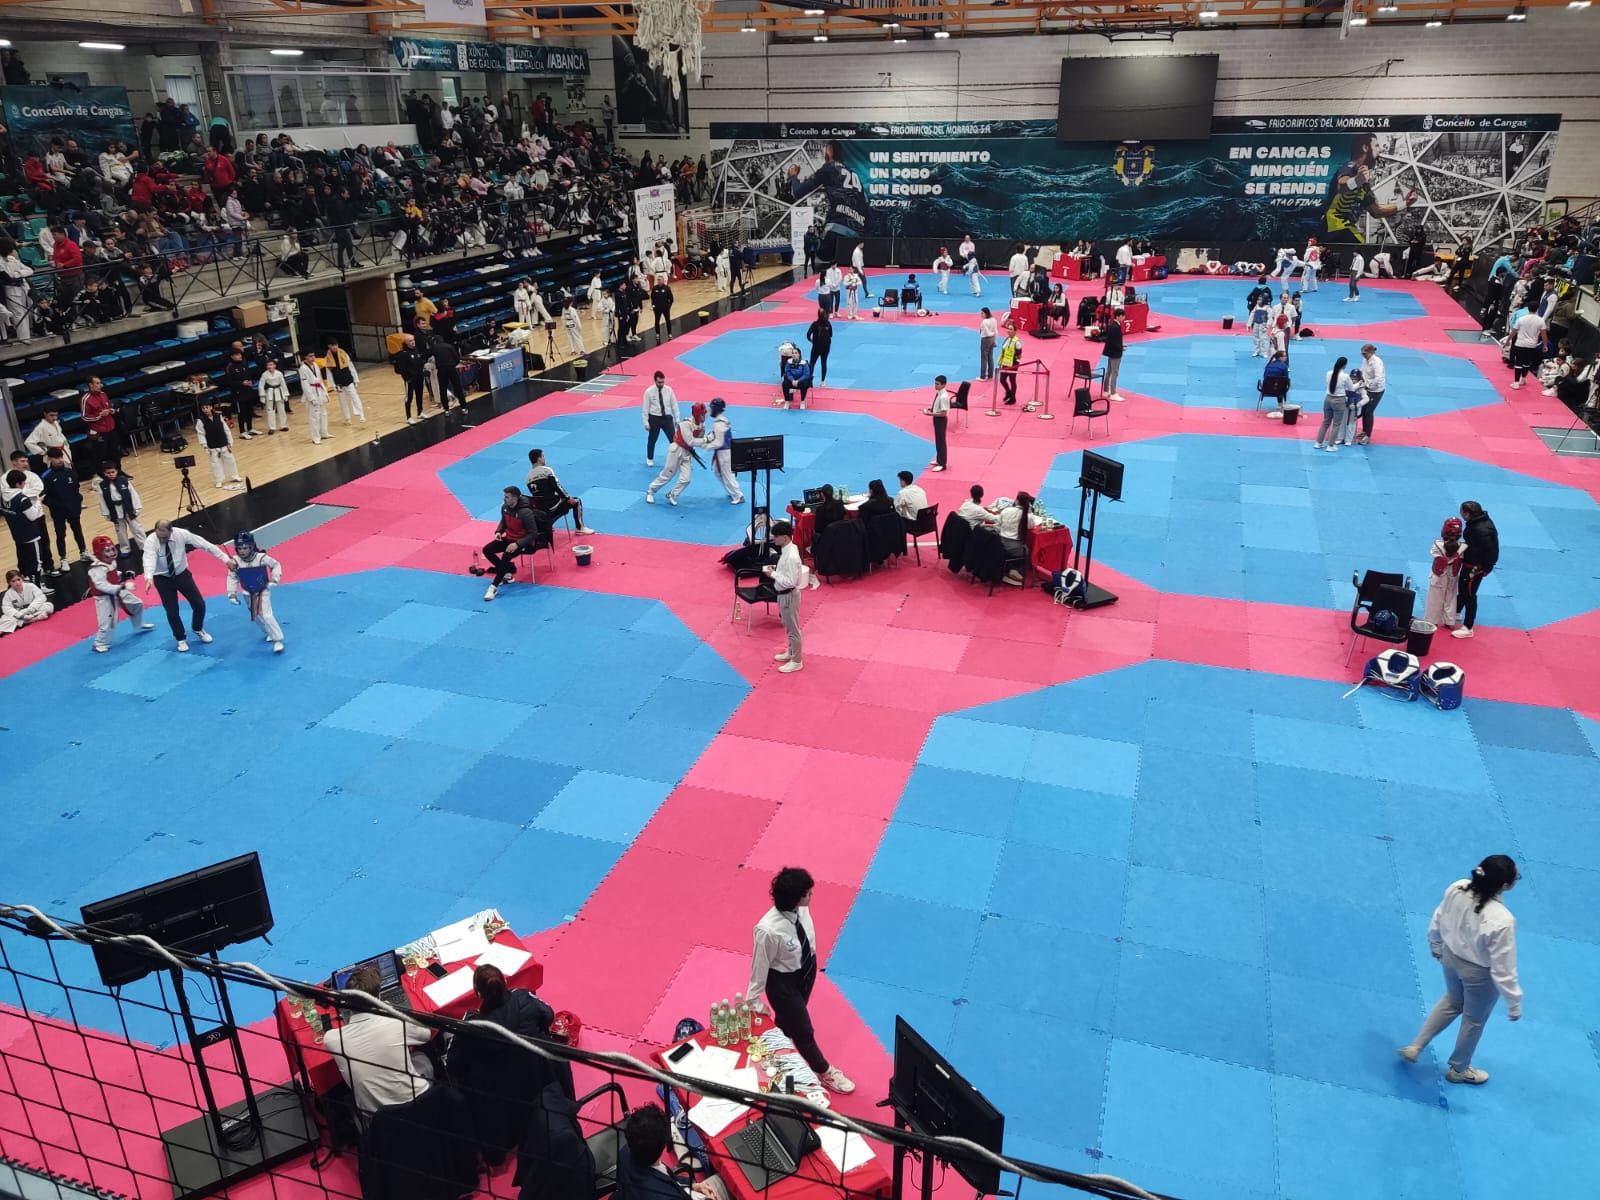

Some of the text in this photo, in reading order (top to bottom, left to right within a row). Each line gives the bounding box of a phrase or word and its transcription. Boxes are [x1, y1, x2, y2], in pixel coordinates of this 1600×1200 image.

[468, 47, 489, 57] XUNTA
[469, 58, 478, 68] DE
[22, 106, 123, 119] Concello de Cangas
[1320, 119, 1333, 128] DEL
[1435, 118, 1528, 129] Concello de Cangas
[789, 127, 819, 136] Concello
[831, 127, 857, 137] Cangas
[869, 150, 991, 163] UN SENTIMIENTO
[1229, 146, 1331, 159] EN CANGAS
[869, 167, 930, 179] UN POBO
[1250, 161, 1329, 177] NINGUÉN
[869, 183, 943, 196] UN EQUIPO
[1244, 182, 1327, 195] SE RENDE
